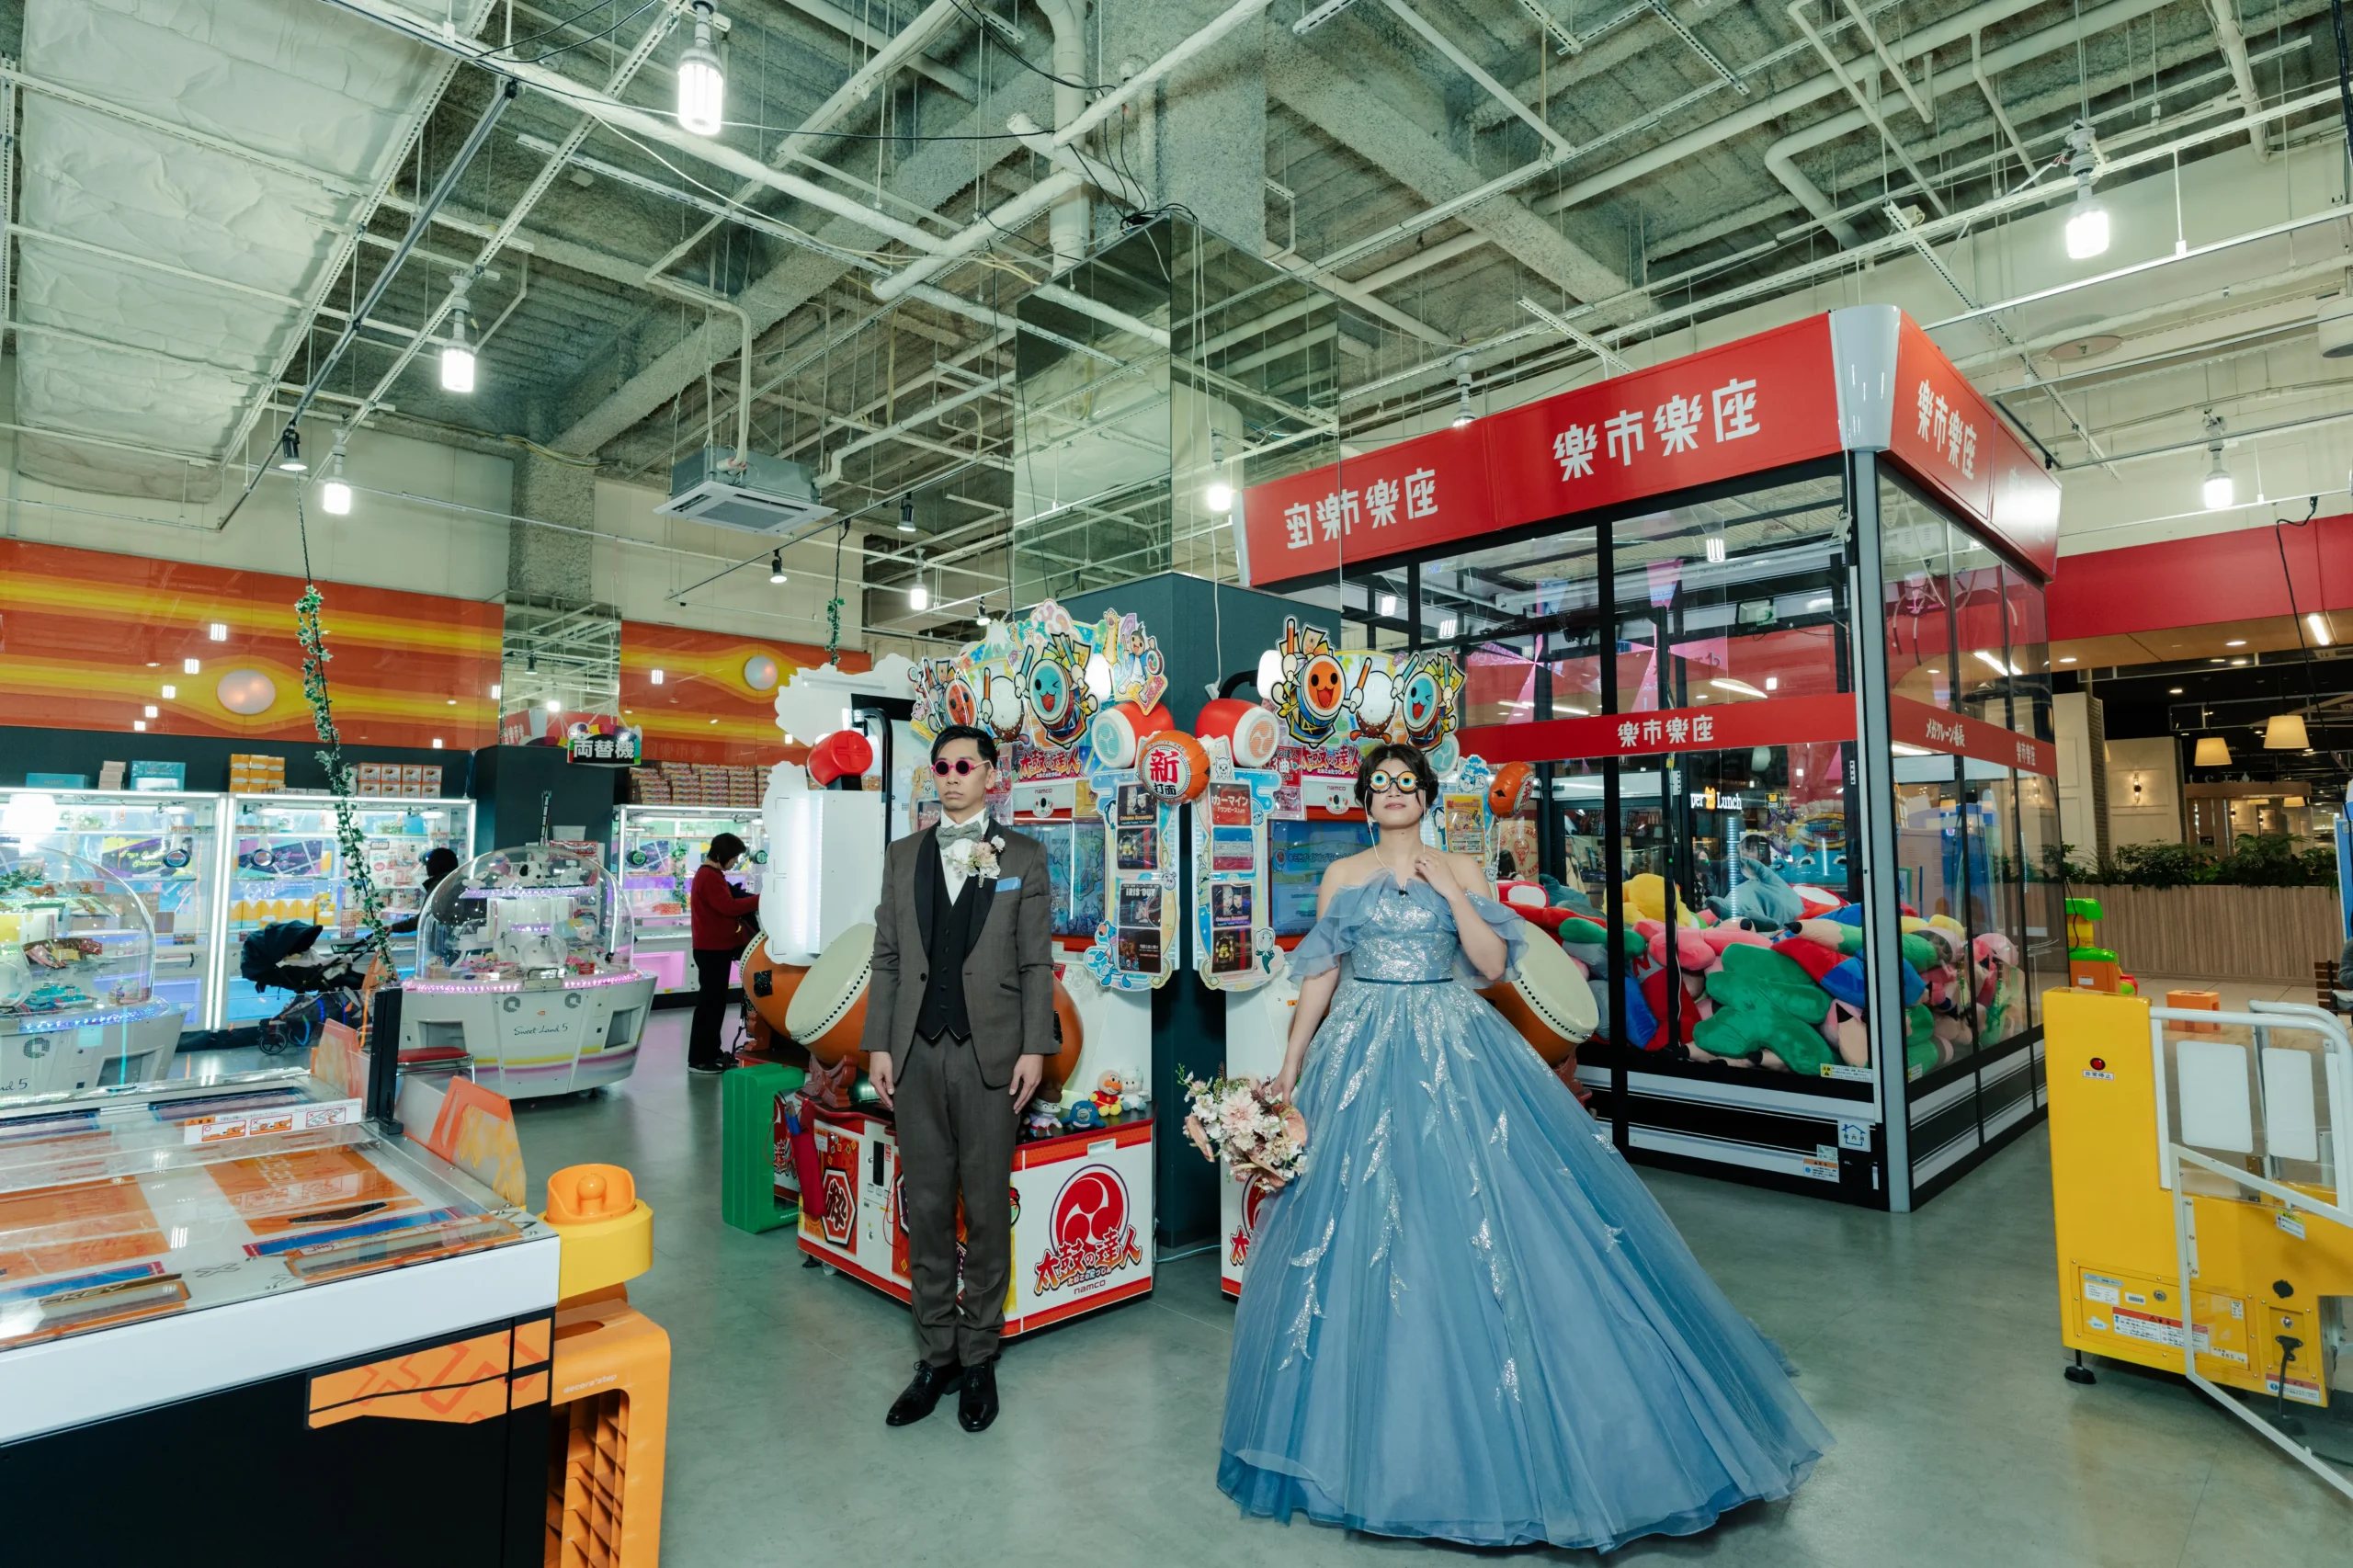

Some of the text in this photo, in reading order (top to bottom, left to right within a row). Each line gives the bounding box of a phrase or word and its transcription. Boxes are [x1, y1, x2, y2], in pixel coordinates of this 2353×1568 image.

[1552, 378, 1760, 482] 樂市樂座
[1917, 380, 1977, 481] 樂市樂座
[1618, 714, 1714, 748] 樂市樂座
[574, 739, 635, 759] 両替機
[1018, 746, 1082, 780] 太鼓の達人
[1149, 749, 1180, 784] 新
[1154, 782, 1177, 796] 打面
[1213, 794, 1249, 807] カーマイン
[1716, 791, 1743, 810] Lunch
[562, 1022, 568, 1032] 5
[18, 1077, 28, 1089] 5
[1034, 1224, 1142, 1297] 太鼓の達人
[1074, 1279, 1107, 1295] namco
